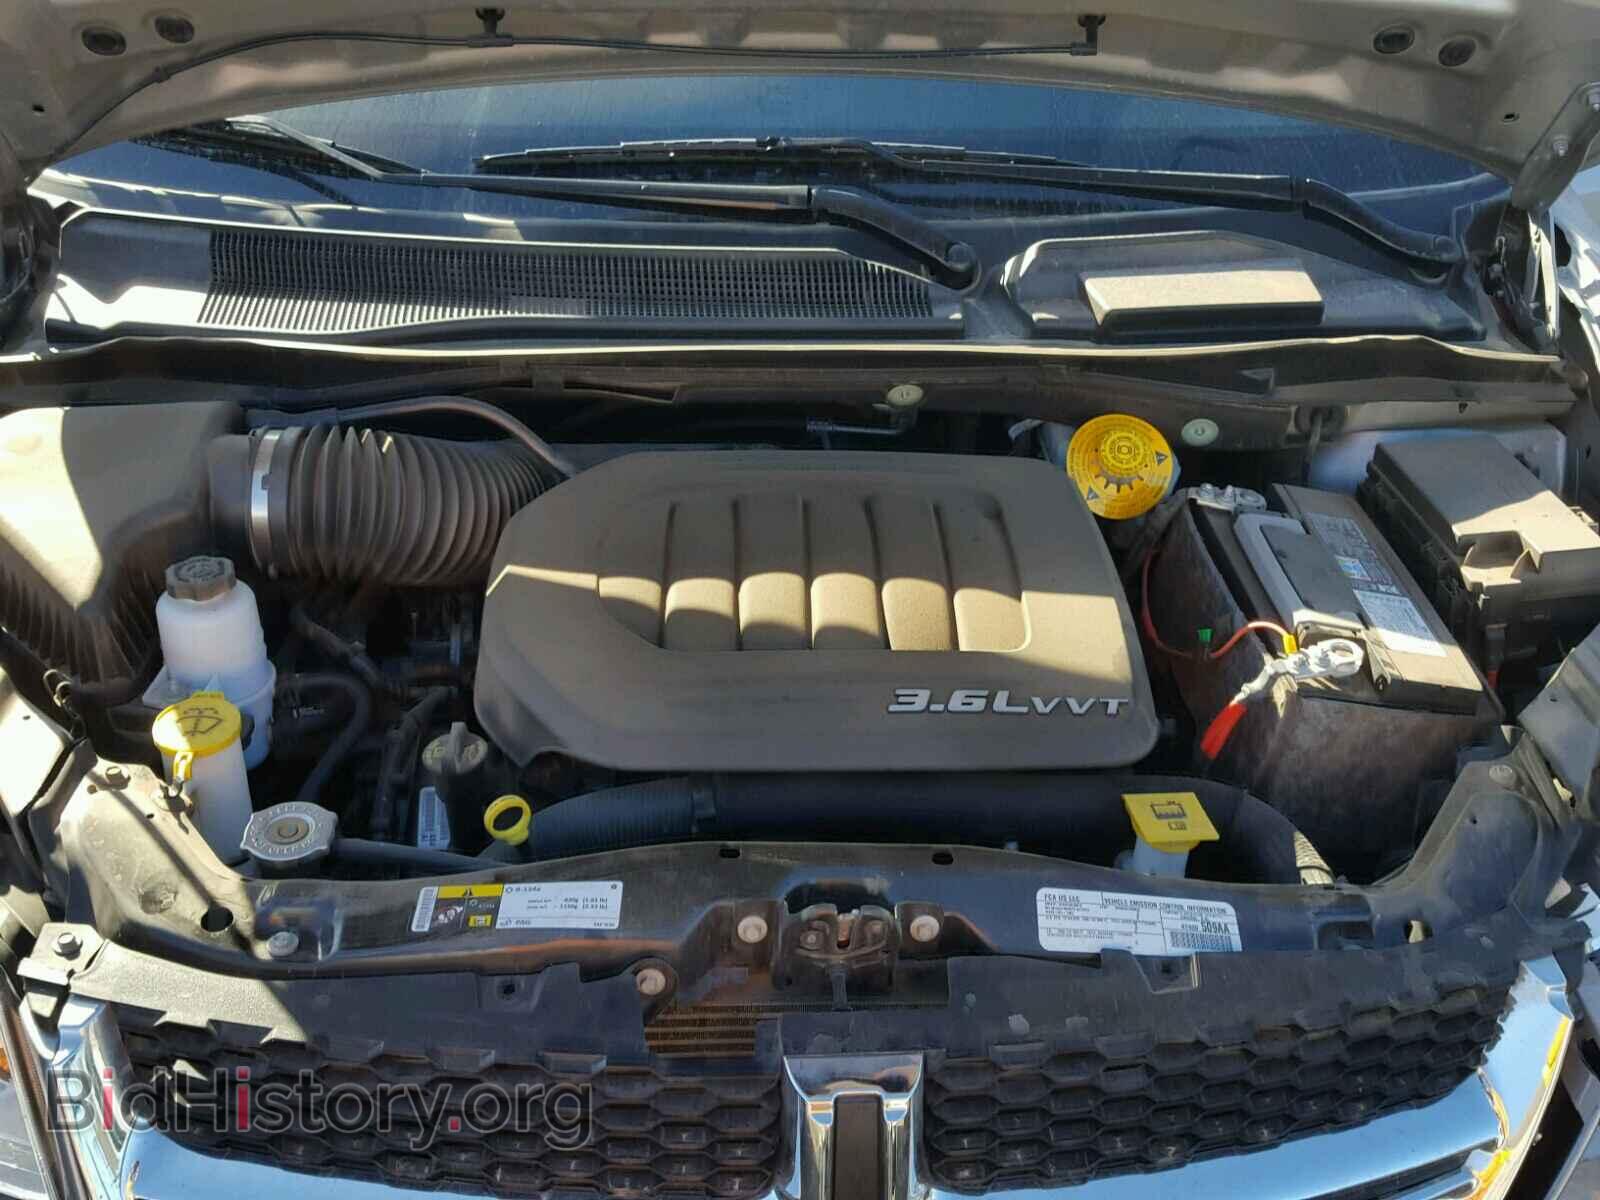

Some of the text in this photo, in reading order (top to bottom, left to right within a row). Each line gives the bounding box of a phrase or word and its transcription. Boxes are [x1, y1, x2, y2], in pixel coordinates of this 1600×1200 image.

[1104, 898, 1128, 906] VEHICLE
[1130, 900, 1158, 909] EMISSION
[1160, 902, 1184, 911] CONTROL
[1186, 905, 1227, 914] INFORMATION
[1201, 921, 1231, 934] 509AA
